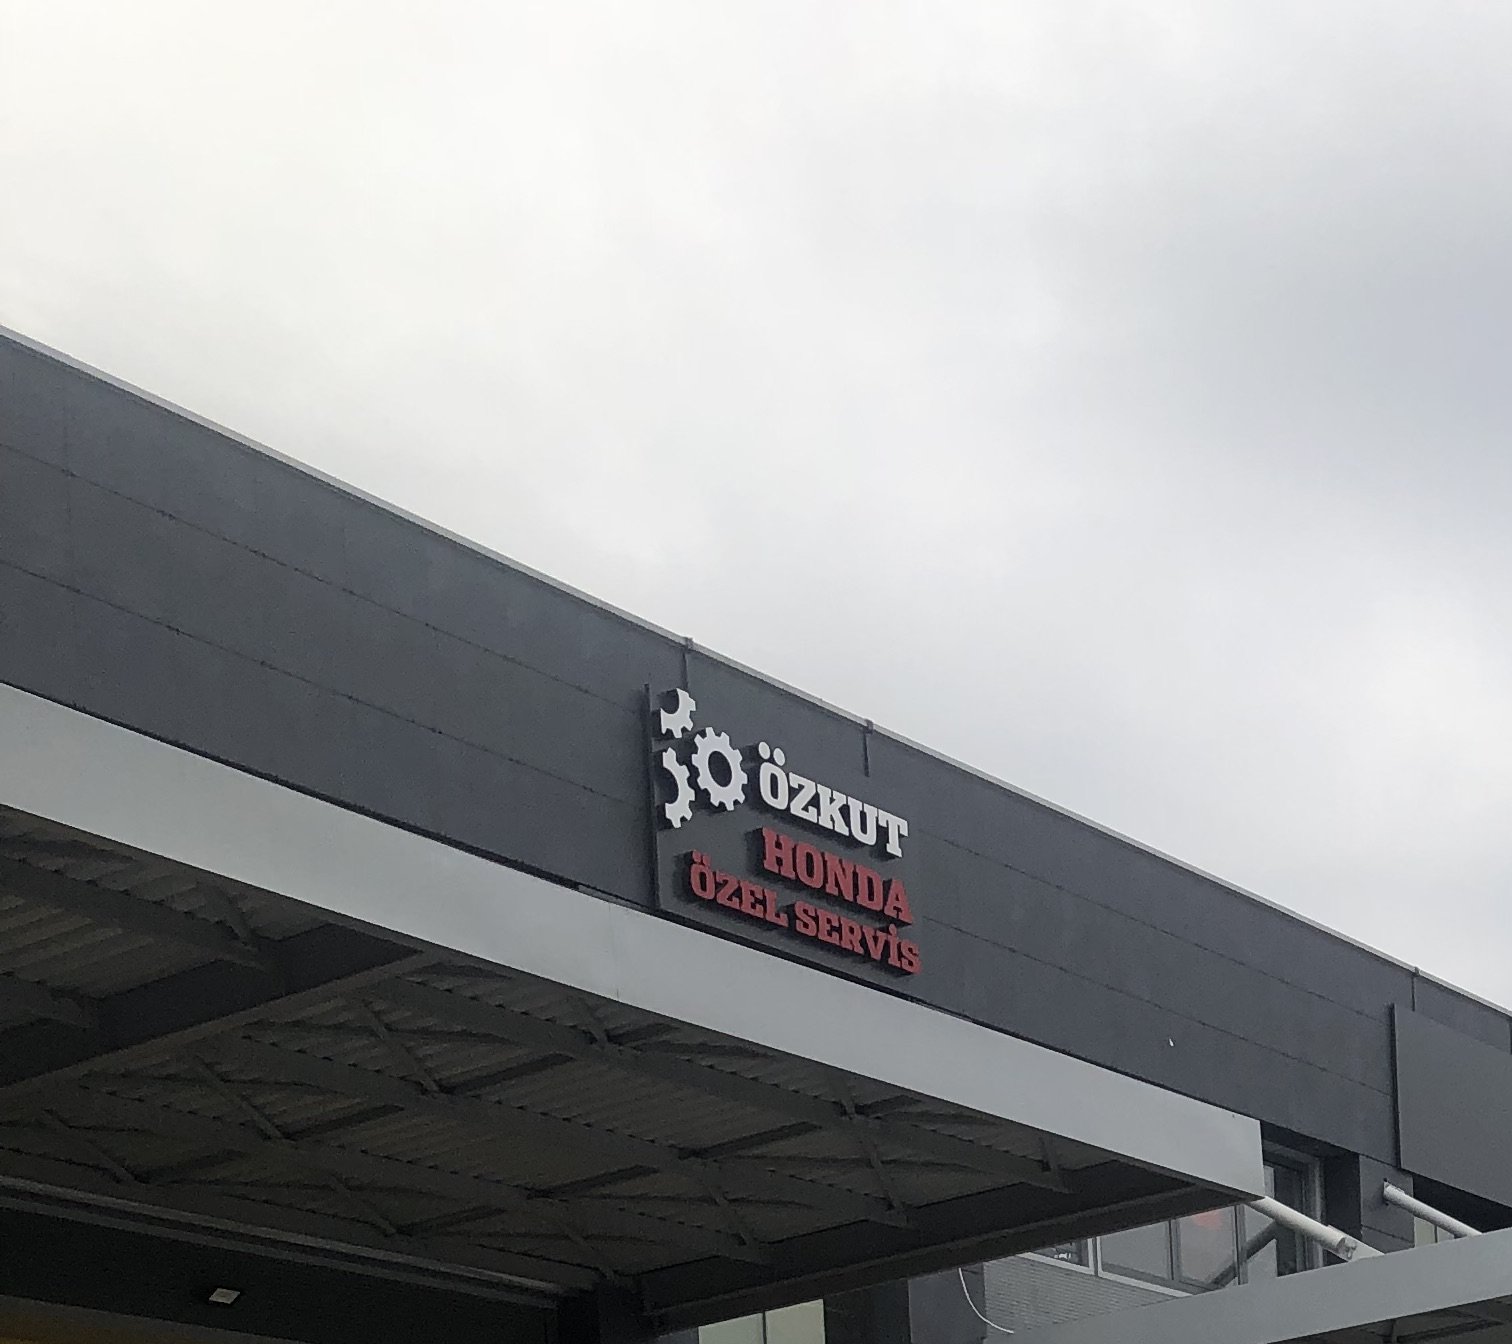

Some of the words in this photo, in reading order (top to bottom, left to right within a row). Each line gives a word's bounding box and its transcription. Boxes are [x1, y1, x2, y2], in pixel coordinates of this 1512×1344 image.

[758, 741, 909, 858] ÖZKUT
[690, 850, 788, 927] ÖZEL
[794, 901, 921, 975] SERVİS
[762, 827, 912, 924] HONDA
